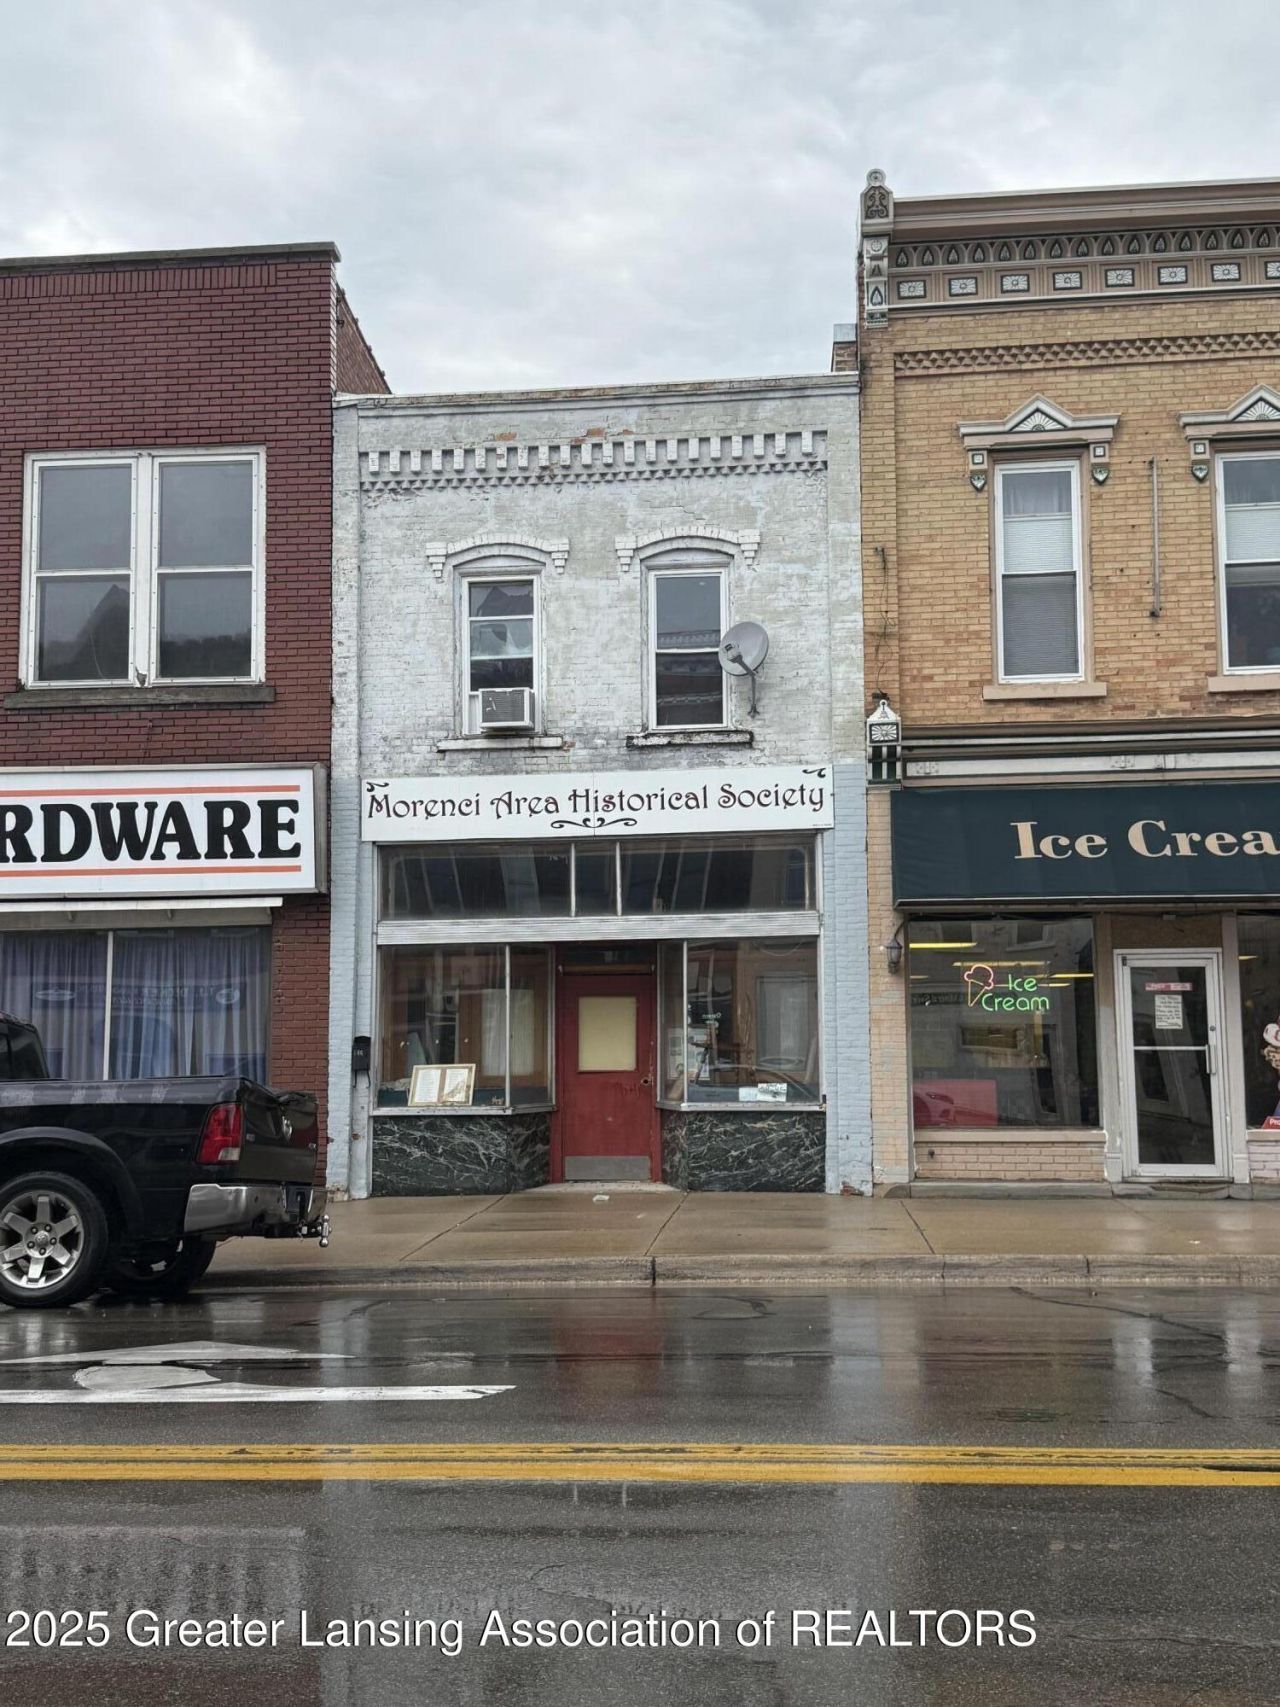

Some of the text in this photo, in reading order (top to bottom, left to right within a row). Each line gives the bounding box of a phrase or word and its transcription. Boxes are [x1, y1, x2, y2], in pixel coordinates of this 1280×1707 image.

[367, 783, 826, 819] Morenci Area Historical Society
[1010, 819, 1280, 859] Ice Crea
[1008, 973, 1038, 992] Ice
[981, 993, 1050, 1012] Cream
